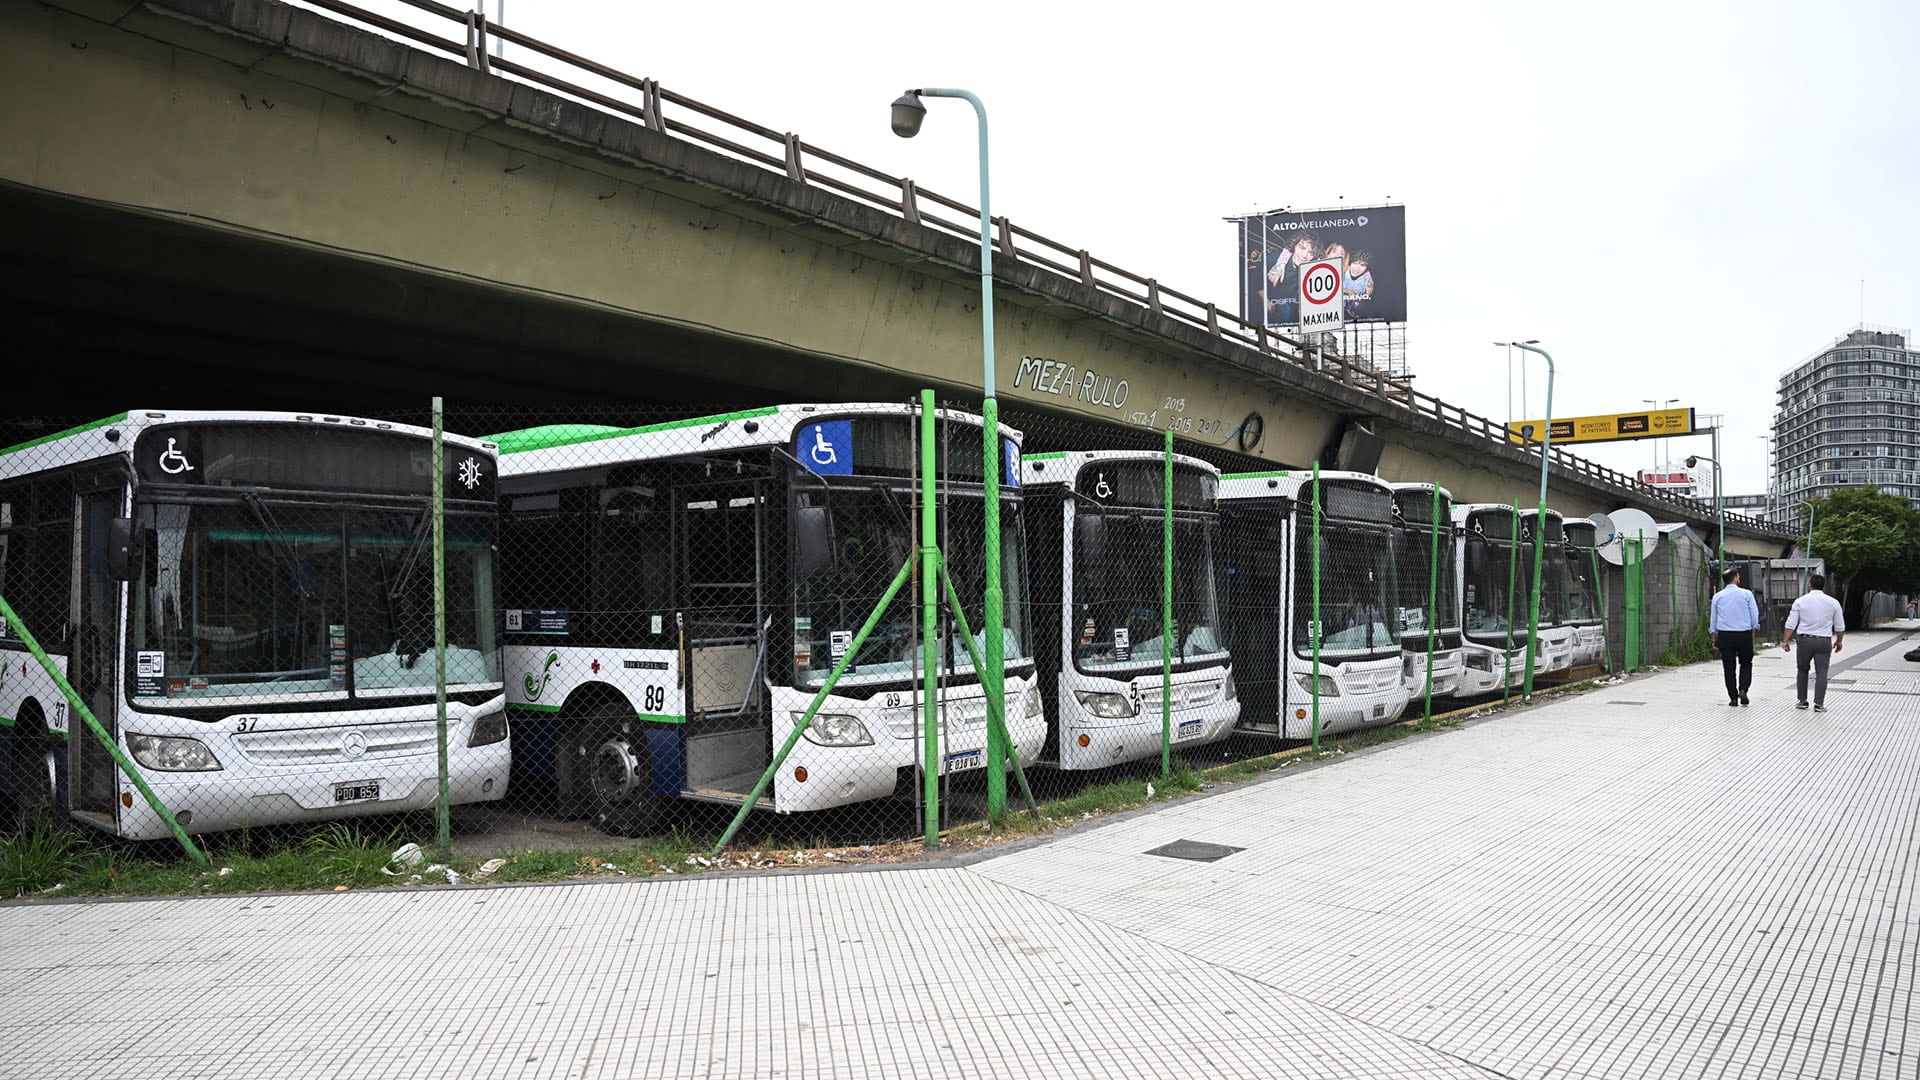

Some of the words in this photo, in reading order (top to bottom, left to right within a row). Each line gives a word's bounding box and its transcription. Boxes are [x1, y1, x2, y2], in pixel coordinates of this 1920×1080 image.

[1272, 218, 1355, 231] ALTOAVELLANEDA
[1308, 274, 1334, 294] 100
[1303, 311, 1340, 327] MAXIMA
[1168, 416, 1192, 433] 2015
[509, 615, 519, 626] 61
[645, 685, 664, 711] 89
[886, 693, 900, 707] 89
[54, 702, 65, 728] 37
[237, 717, 258, 732] 37
[360, 786, 378, 798] 852
